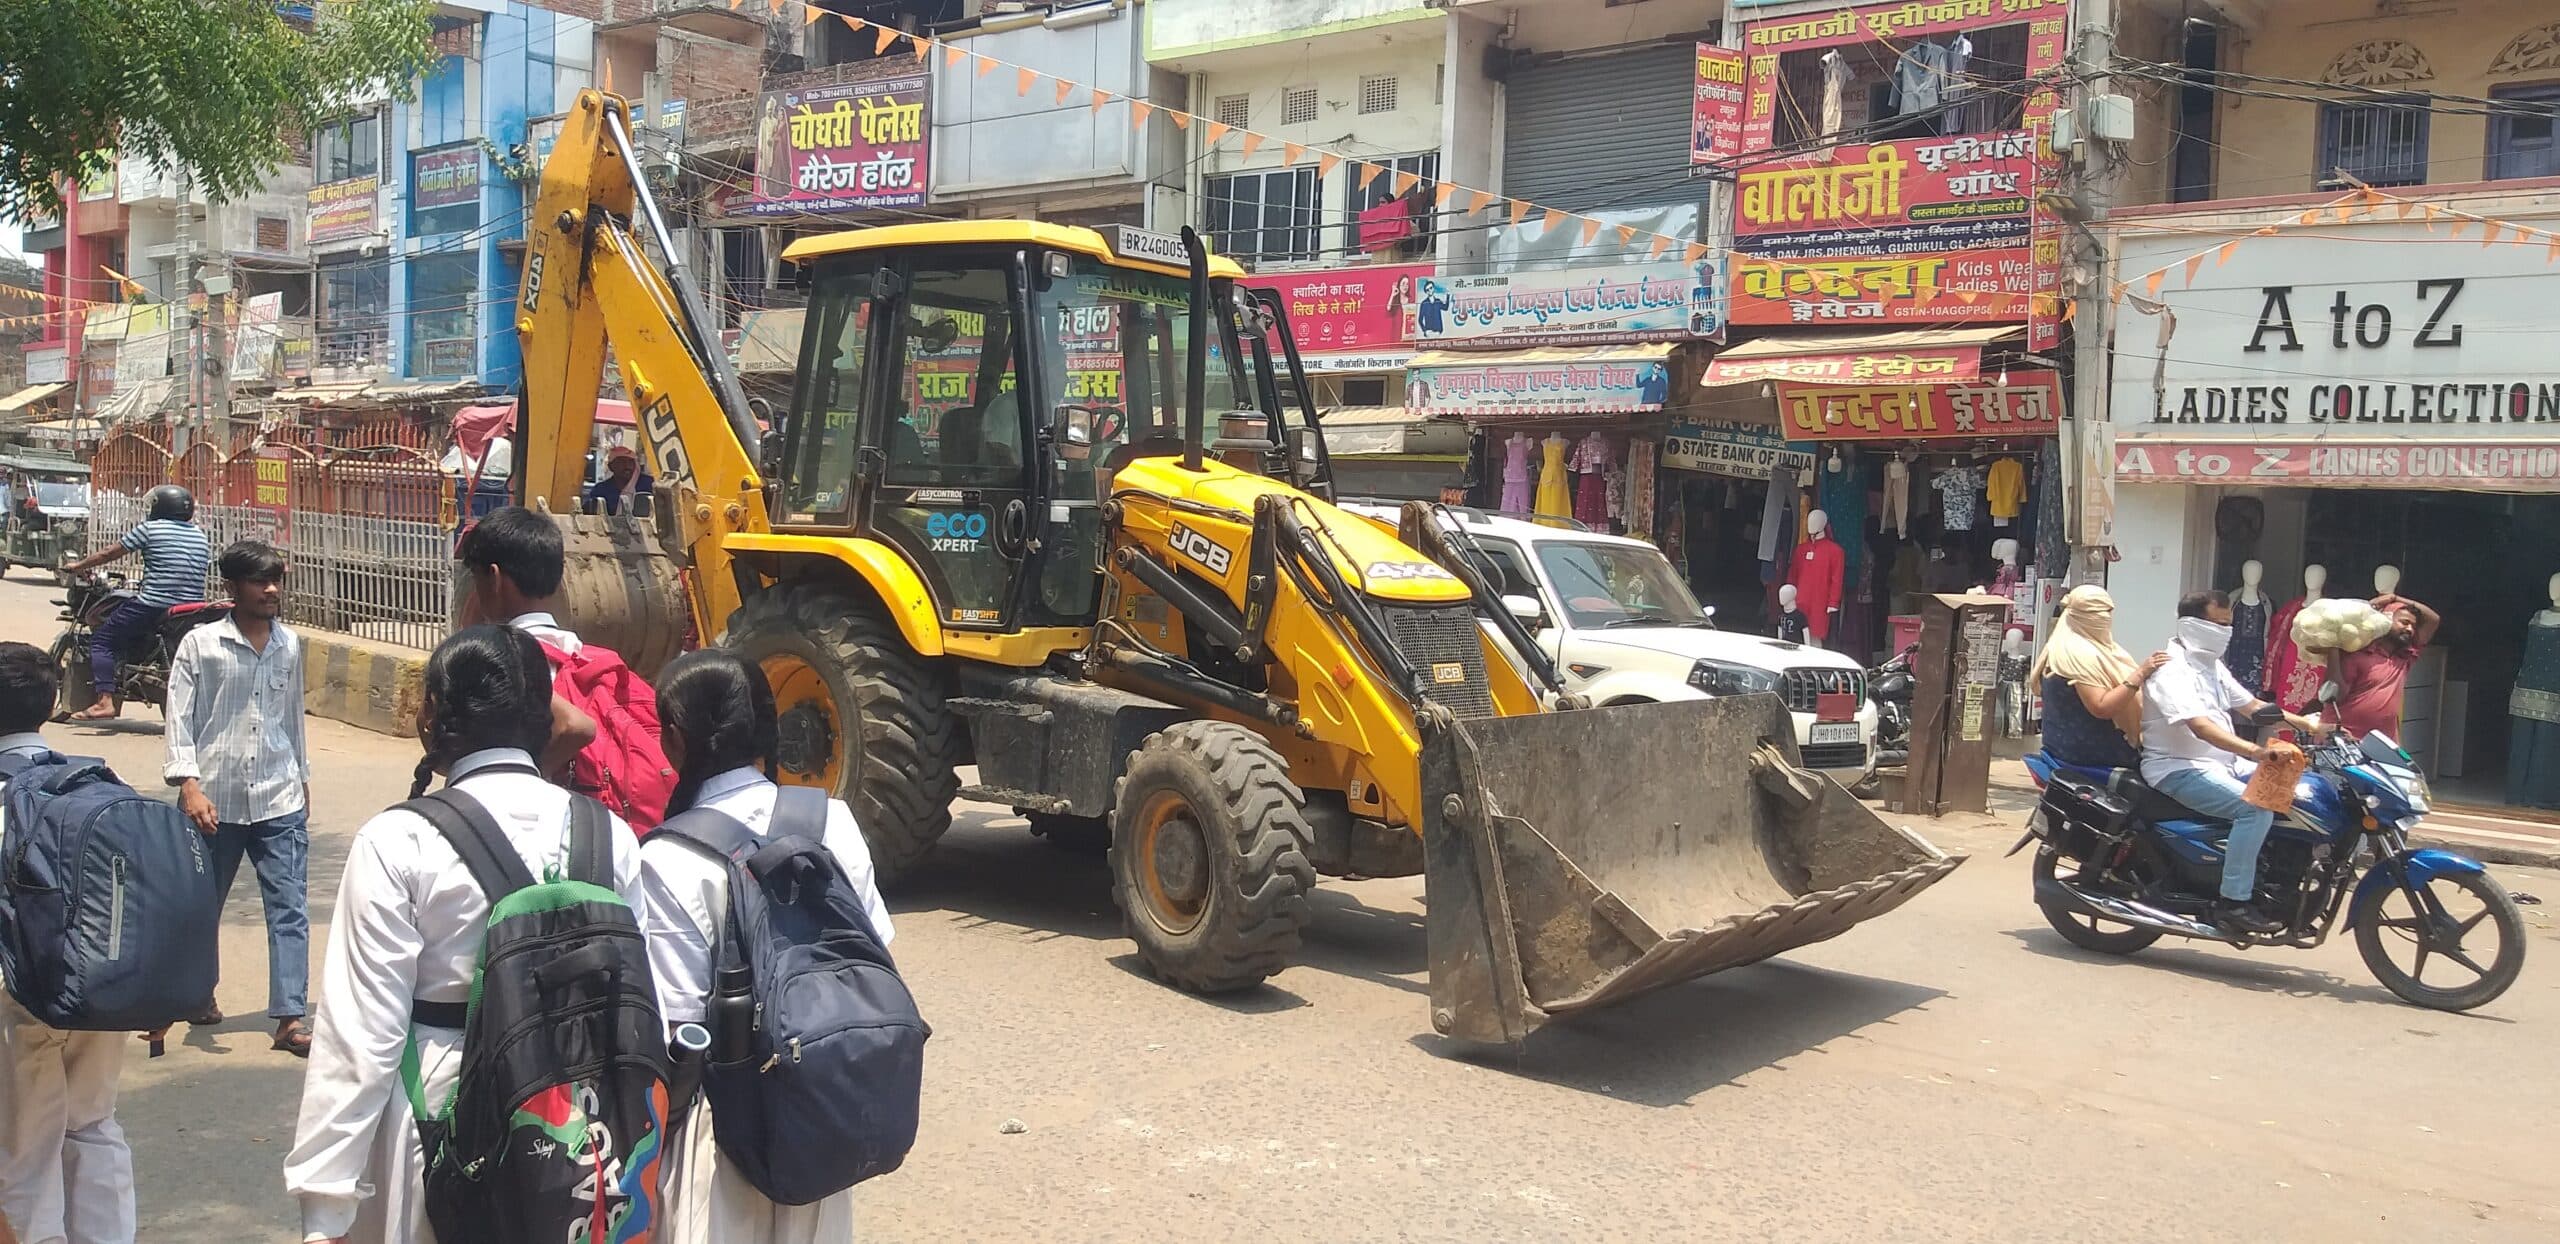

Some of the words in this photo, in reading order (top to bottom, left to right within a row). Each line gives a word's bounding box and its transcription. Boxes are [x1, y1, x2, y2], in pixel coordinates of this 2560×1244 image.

[1750, 11, 1860, 45] बालाजी
[1697, 56, 1745, 85] बालाजी
[790, 100, 856, 150] चौधरी
[859, 95, 924, 145] पैलेस
[799, 154, 857, 191] मैरेज
[861, 151, 915, 191] हॉल
[1740, 145, 1908, 224] बालाजी
[1947, 168, 2019, 197] शॉप
[524, 255, 545, 309] 40X
[1742, 259, 1946, 299] वन्दना
[1957, 261, 1994, 276] Kids
[1999, 260, 2031, 276] Wea
[1292, 283, 1327, 298] क्वालिटी
[1330, 285, 1341, 296] का
[1946, 277, 1998, 293] Ladies
[2004, 277, 2030, 292] We
[1293, 301, 1314, 316] लिख
[1318, 299, 1328, 315] के
[1331, 299, 1340, 314] ले
[1789, 299, 1887, 321] ड्रेसेज
[2244, 286, 2303, 352] A
[2330, 291, 2391, 348] to
[2413, 278, 2465, 348] Z
[917, 372, 970, 399] राज
[1434, 371, 1482, 399] गुनगुन
[1484, 367, 1528, 397] किड्स
[1600, 365, 1637, 391] वेयर
[1786, 384, 1938, 433] वन्दना
[1946, 376, 2053, 431] ड्रेसेज
[2154, 386, 2289, 424] LADIES
[2309, 382, 2560, 423] COLLECTION
[647, 407, 697, 495] JC
[1682, 439, 1719, 459] STATE
[1722, 445, 1755, 463] BANK
[1758, 449, 1775, 466] OF
[1778, 453, 1813, 471] INDIA
[2117, 447, 2156, 475] A
[2174, 448, 2231, 476] to
[2250, 448, 2290, 476] Z
[2309, 447, 2400, 477] LADIES
[2407, 447, 2560, 480] COLLECTIO
[917, 490, 963, 499] EASYCONTROL
[927, 512, 986, 537] eco
[932, 538, 979, 552] XPERT
[1170, 526, 1232, 575] JCB
[1437, 666, 1461, 679] JCB
[186, 827, 205, 875] safari
